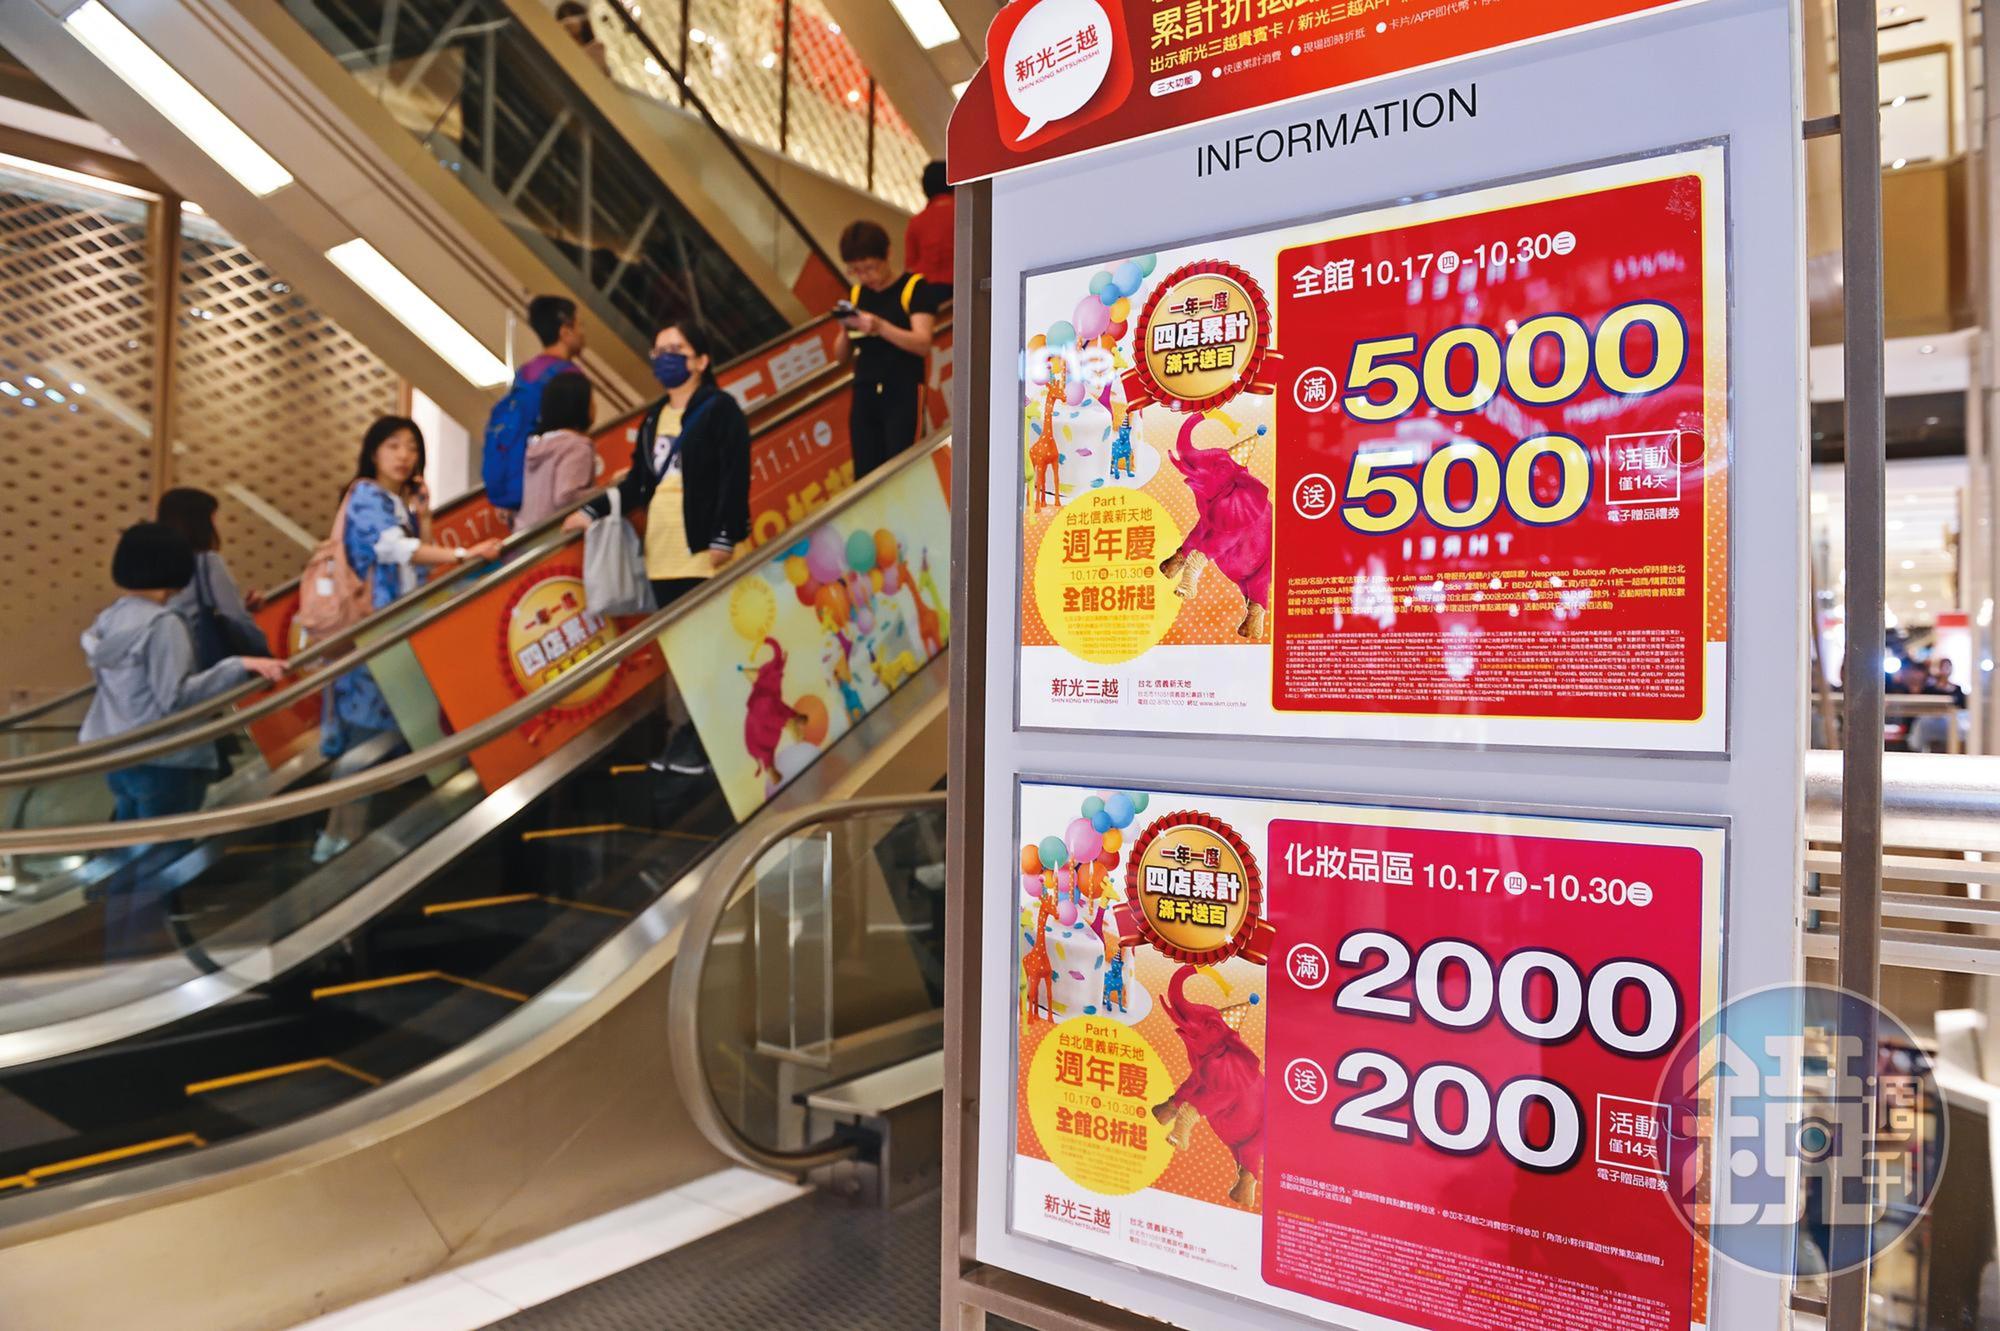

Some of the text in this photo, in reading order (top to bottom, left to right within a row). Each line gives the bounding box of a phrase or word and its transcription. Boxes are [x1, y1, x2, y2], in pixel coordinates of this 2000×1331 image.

[1151, 0, 1320, 49] 累計折
[1015, 24, 1098, 82] 新光三越
[1150, 22, 1284, 74] 出示新光三越貴賓卡
[1223, 51, 1282, 75] 快速累計消費
[1156, 75, 1194, 94] 三大功能
[1197, 83, 1478, 178] INFORMATION
[1292, 258, 1355, 298] 全館
[1170, 292, 1228, 316] 一年一度
[1153, 312, 1249, 352] 四店累計
[1165, 346, 1235, 375] 滿千送百
[1299, 300, 1688, 424] 滿 5000
[1619, 446, 1668, 471] 活動
[1298, 433, 1592, 535] 送 500
[1619, 475, 1667, 491] 僅14天
[1093, 496, 1116, 507] Part
[1608, 507, 1680, 522] 電子贈品禮券
[1066, 508, 1153, 527] 台北信義新天地
[1062, 526, 1156, 563] 週年慶
[1531, 570, 1569, 578] Nespresso
[1573, 569, 1605, 578] Boutique
[1062, 585, 1155, 612] 全館8折起
[1051, 678, 1119, 699] 新光三越
[1138, 680, 1192, 690] 台北 信義新天地
[1161, 846, 1220, 867] 一年一度
[1284, 843, 1414, 886] 化妝品區
[1145, 867, 1240, 903] 四店累計
[1158, 899, 1227, 926] 滿千送百
[1292, 929, 1681, 1057] 滿 2000
[1086, 1023, 1110, 1038] Part
[1059, 1033, 1144, 1061] 台北信義新天地
[1055, 1050, 1148, 1101] 週年慶
[1290, 1048, 1584, 1172] 送 200
[1056, 1107, 1147, 1151] 全館8折起
[1609, 1111, 1659, 1140] 活動
[1609, 1138, 1657, 1160] 僅14天
[1596, 1168, 1668, 1192] 電子贈品禮券
[1044, 1194, 1111, 1230] 新光三越
